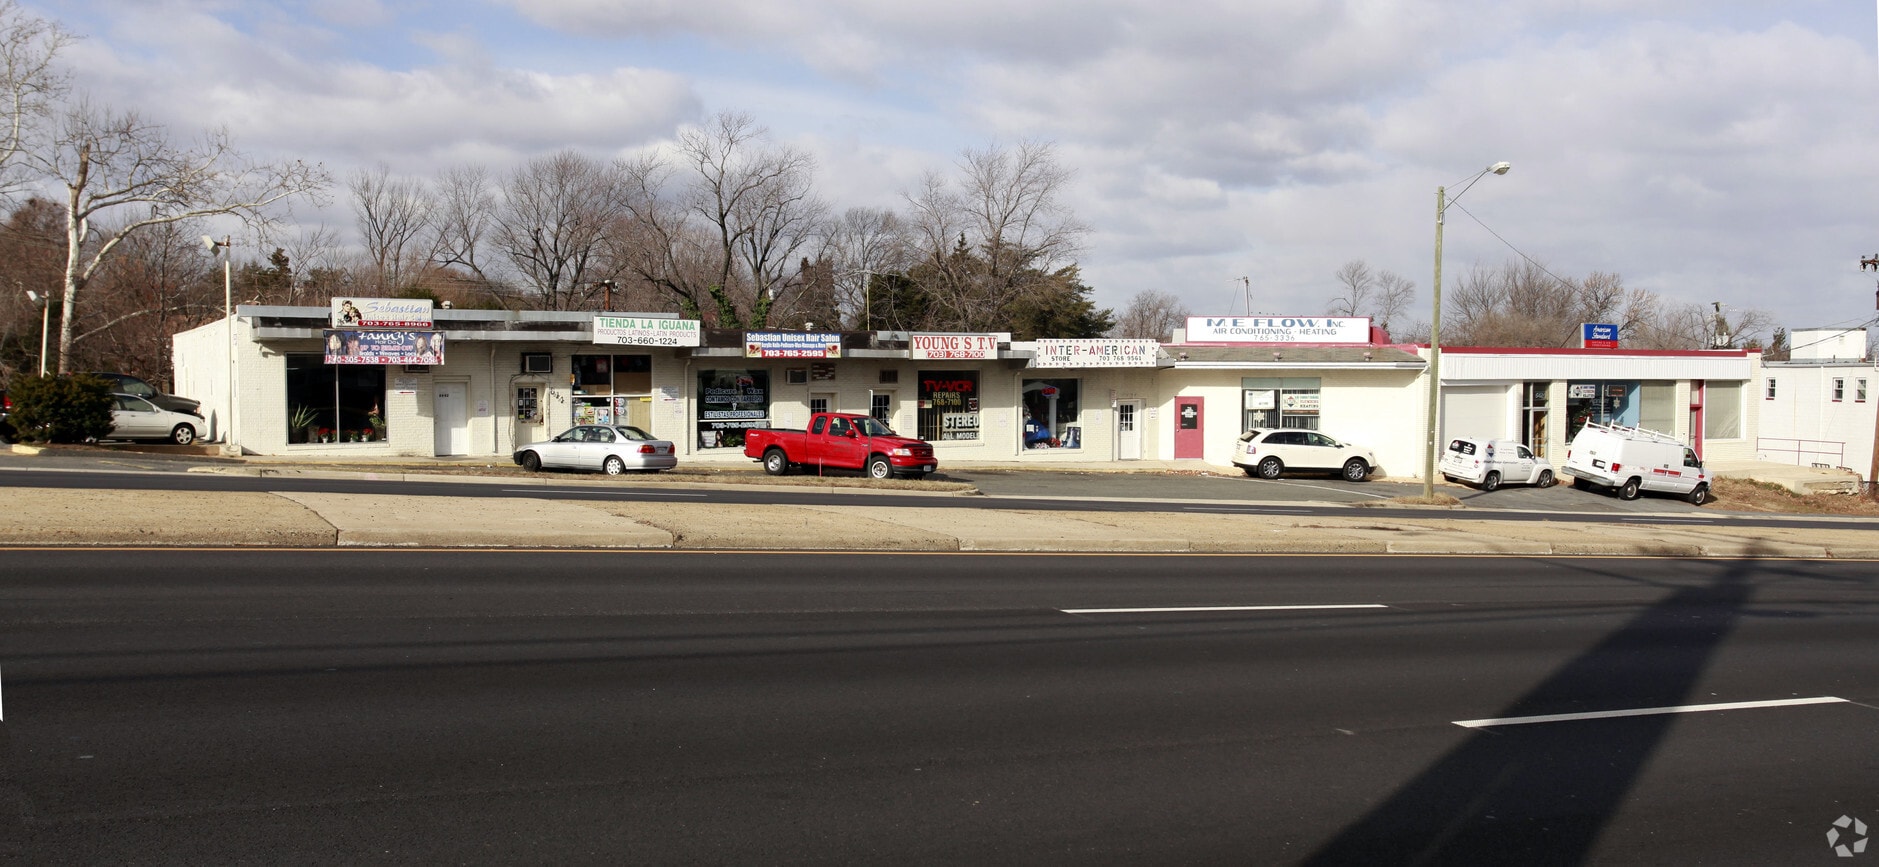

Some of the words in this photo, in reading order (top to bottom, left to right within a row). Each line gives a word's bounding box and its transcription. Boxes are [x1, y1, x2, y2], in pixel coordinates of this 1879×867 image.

[363, 301, 430, 314] Sebastian
[600, 318, 636, 328] TIENDA
[641, 320, 654, 329] LA
[658, 320, 695, 330] IGUANA
[617, 336, 677, 345] 703-660-1224
[746, 332, 781, 342] Sebastian
[782, 333, 804, 342] Unisex
[806, 333, 820, 342] Hair
[820, 334, 840, 342] Salon
[914, 337, 972, 349] YOUNG'S
[977, 337, 996, 350] T.V
[1046, 345, 1146, 355] INTER-AMERICAN
[924, 380, 974, 392] TV-VCR
[704, 410, 730, 419] ESTILISTAS
[944, 415, 979, 429] STEREO
